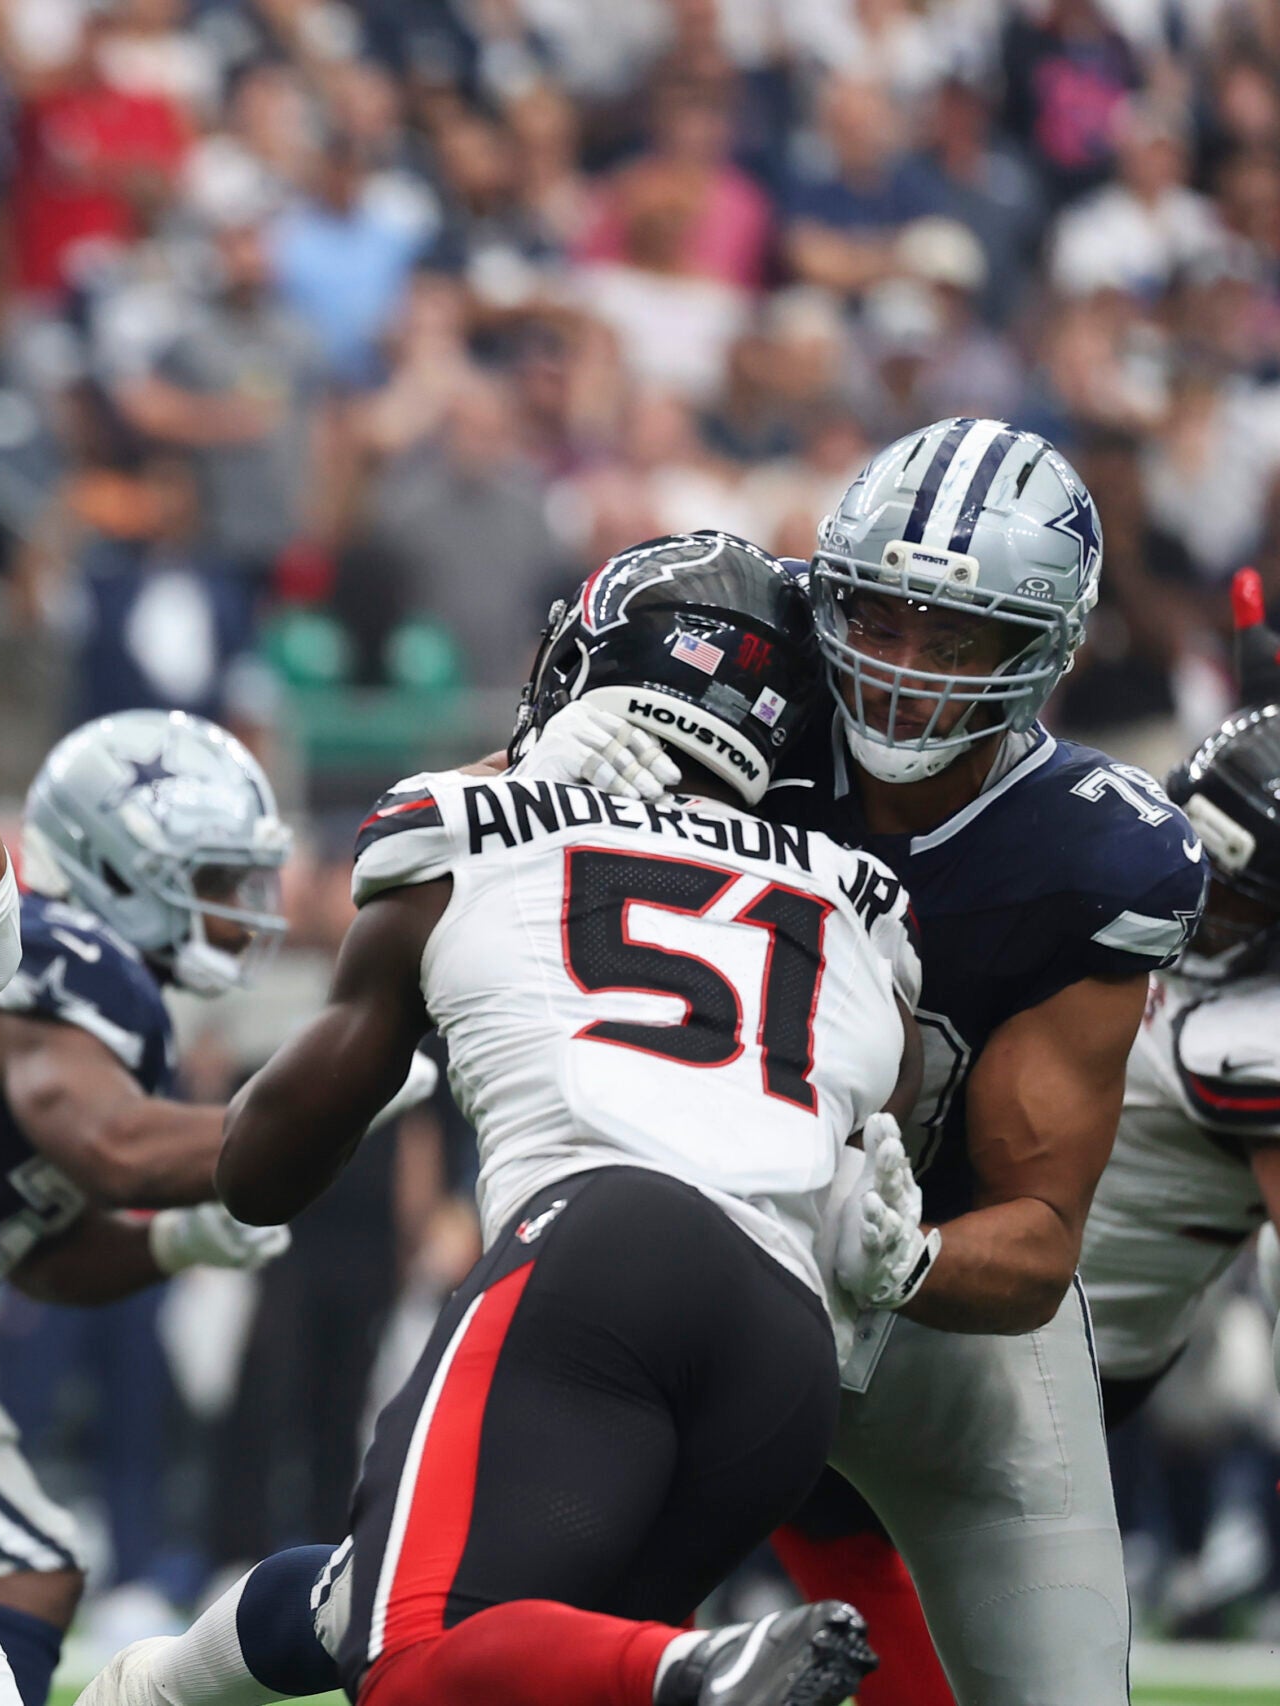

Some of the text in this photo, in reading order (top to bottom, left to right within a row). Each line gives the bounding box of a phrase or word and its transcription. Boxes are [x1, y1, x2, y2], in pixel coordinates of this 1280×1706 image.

[1017, 587, 1052, 600] OAKLEY
[627, 698, 761, 782] HOUSTON
[462, 780, 901, 939] ANDERSON JR
[560, 844, 836, 1118] 51
